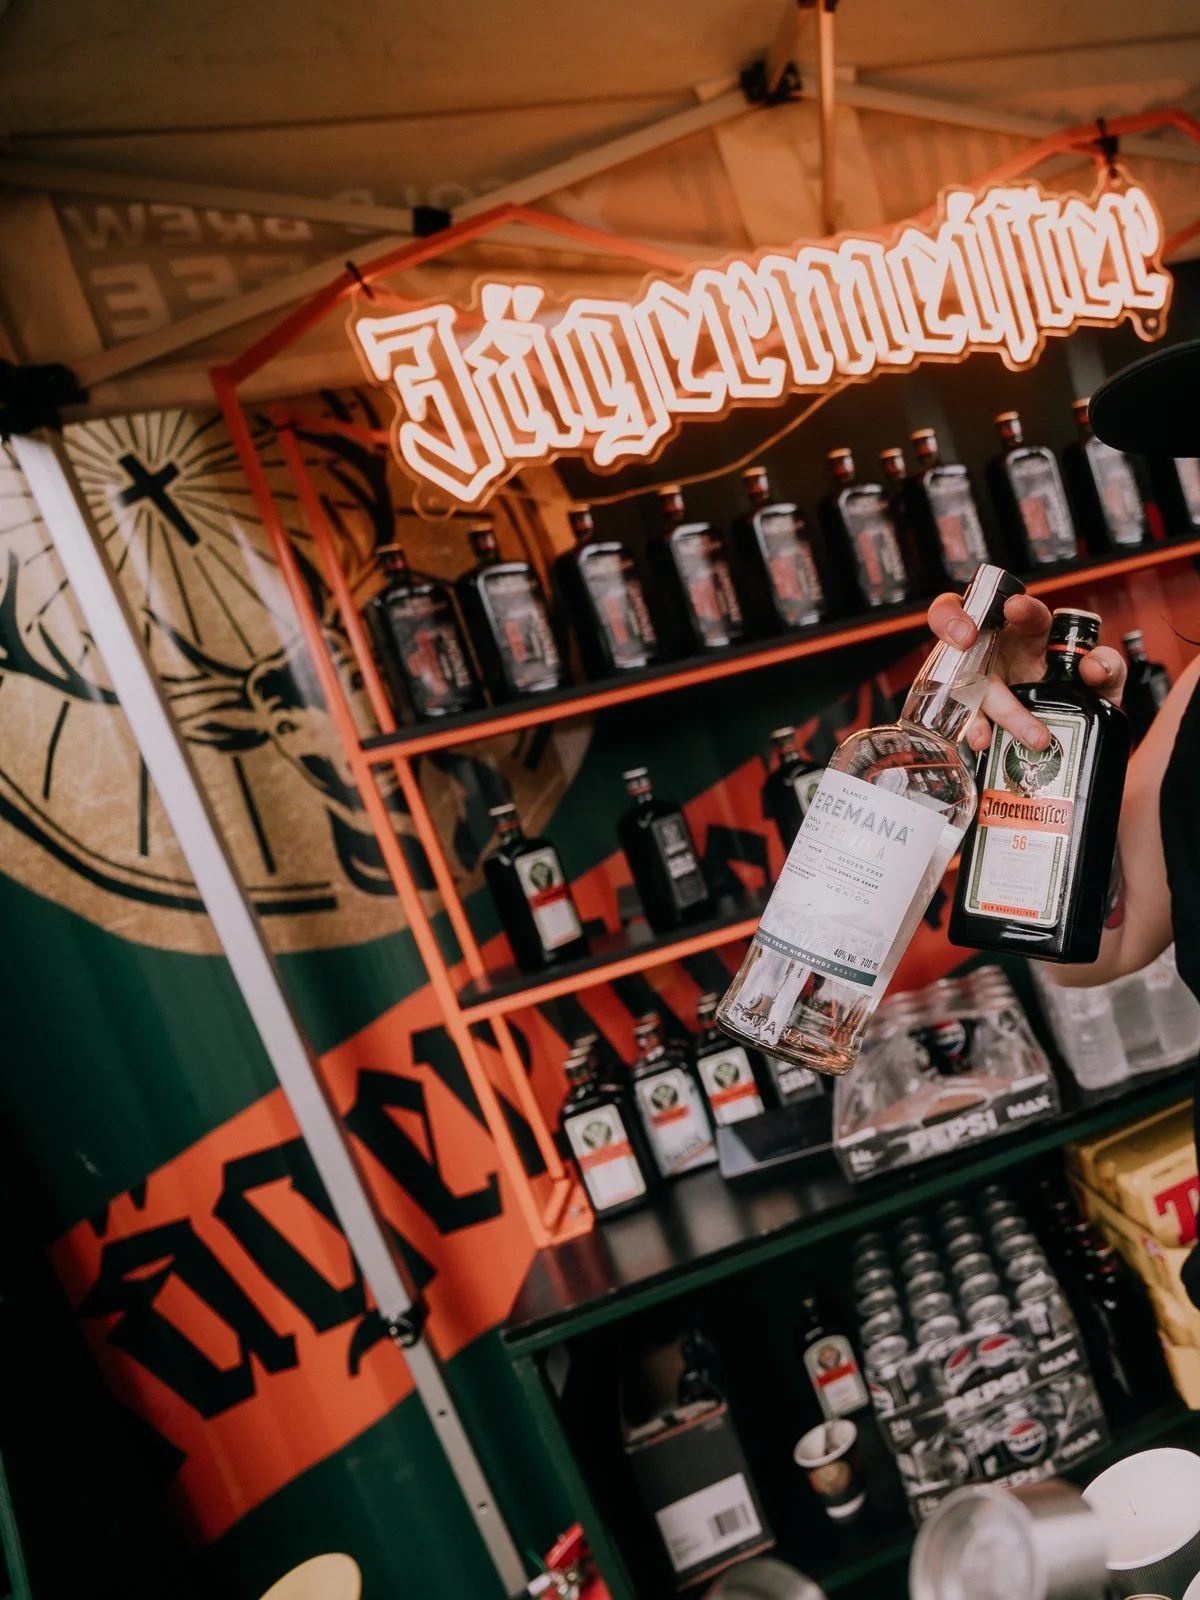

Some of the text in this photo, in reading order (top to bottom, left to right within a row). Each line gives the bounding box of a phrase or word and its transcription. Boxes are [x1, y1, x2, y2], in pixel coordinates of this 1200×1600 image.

[356, 187, 1170, 502] Jägermeister
[842, 787, 868, 801] BLANCO
[816, 791, 909, 846] EREMANA
[983, 797, 1069, 826] Jägermeister
[1012, 834, 1027, 850] 56
[826, 883, 870, 905] MEXICO
[772, 939, 787, 951] FROM
[789, 948, 831, 969] HIGHLANDS
[834, 948, 847, 960] 40%
[860, 957, 873, 970] 700
[907, 1094, 1051, 1156] PEPSI MAX
